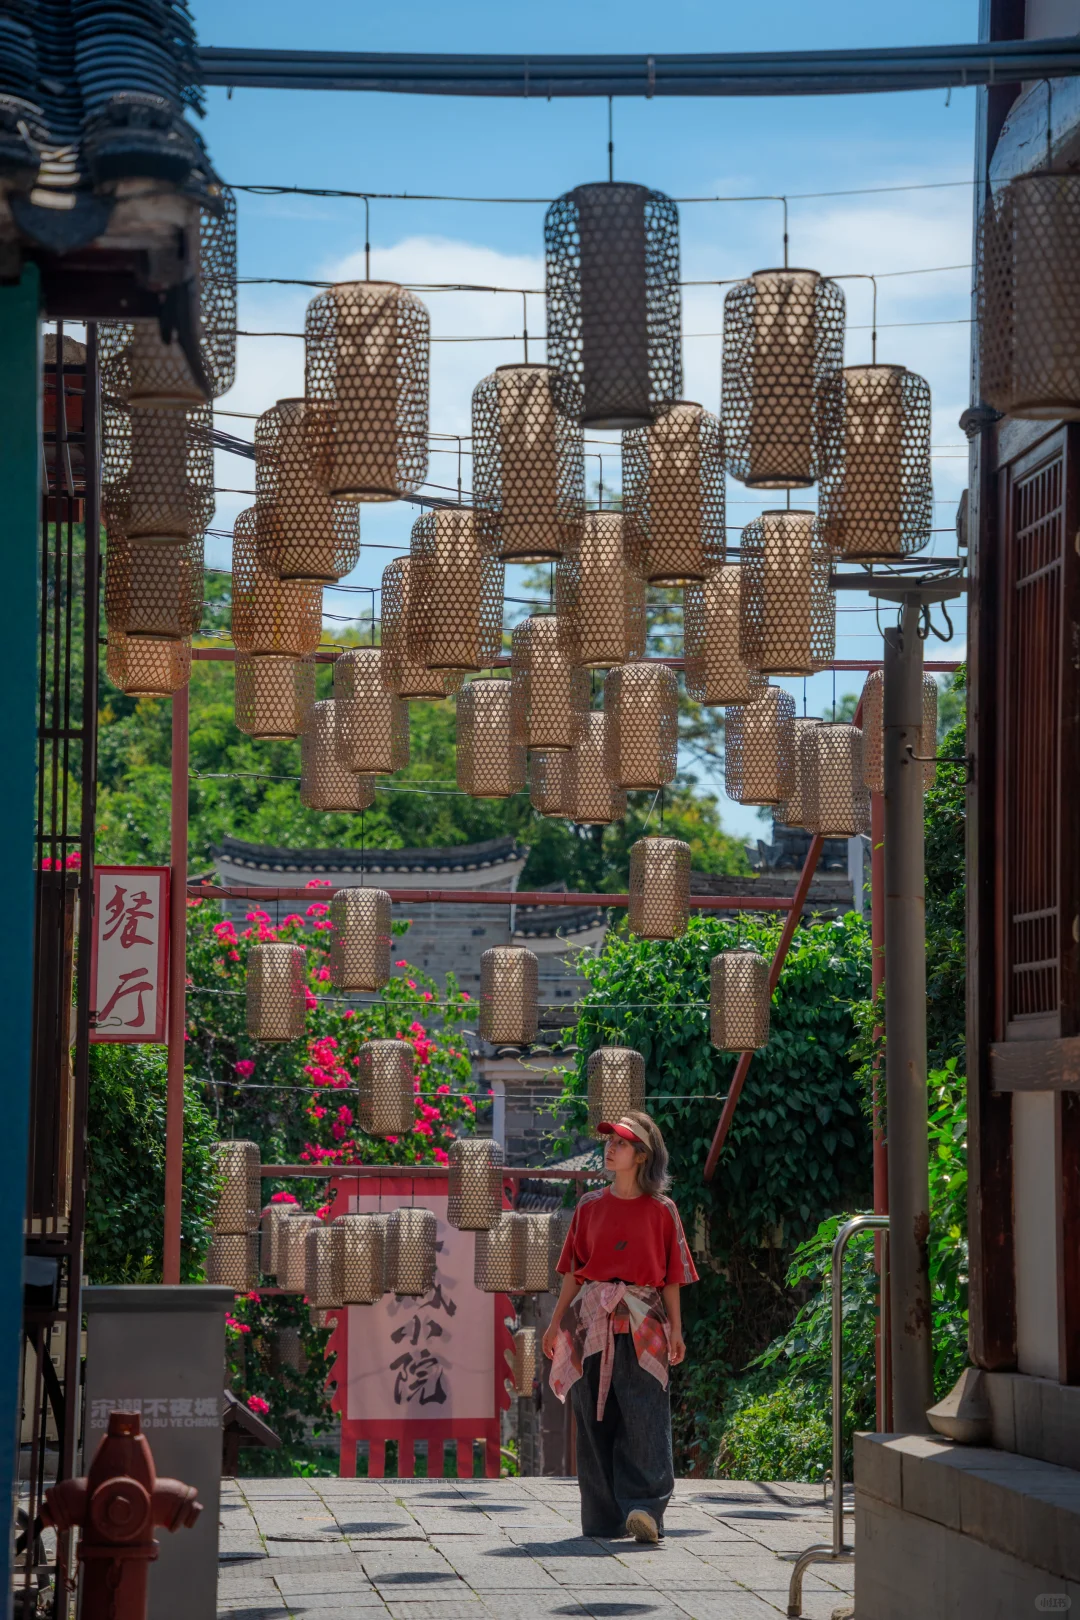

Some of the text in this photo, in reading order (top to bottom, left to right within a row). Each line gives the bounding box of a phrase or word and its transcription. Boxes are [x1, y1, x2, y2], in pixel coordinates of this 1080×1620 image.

[98, 884, 154, 1028] 餐厅
[153, 1418, 168, 1428] BU
[169, 1418, 183, 1428] YE
[184, 1418, 220, 1428] CHENG
